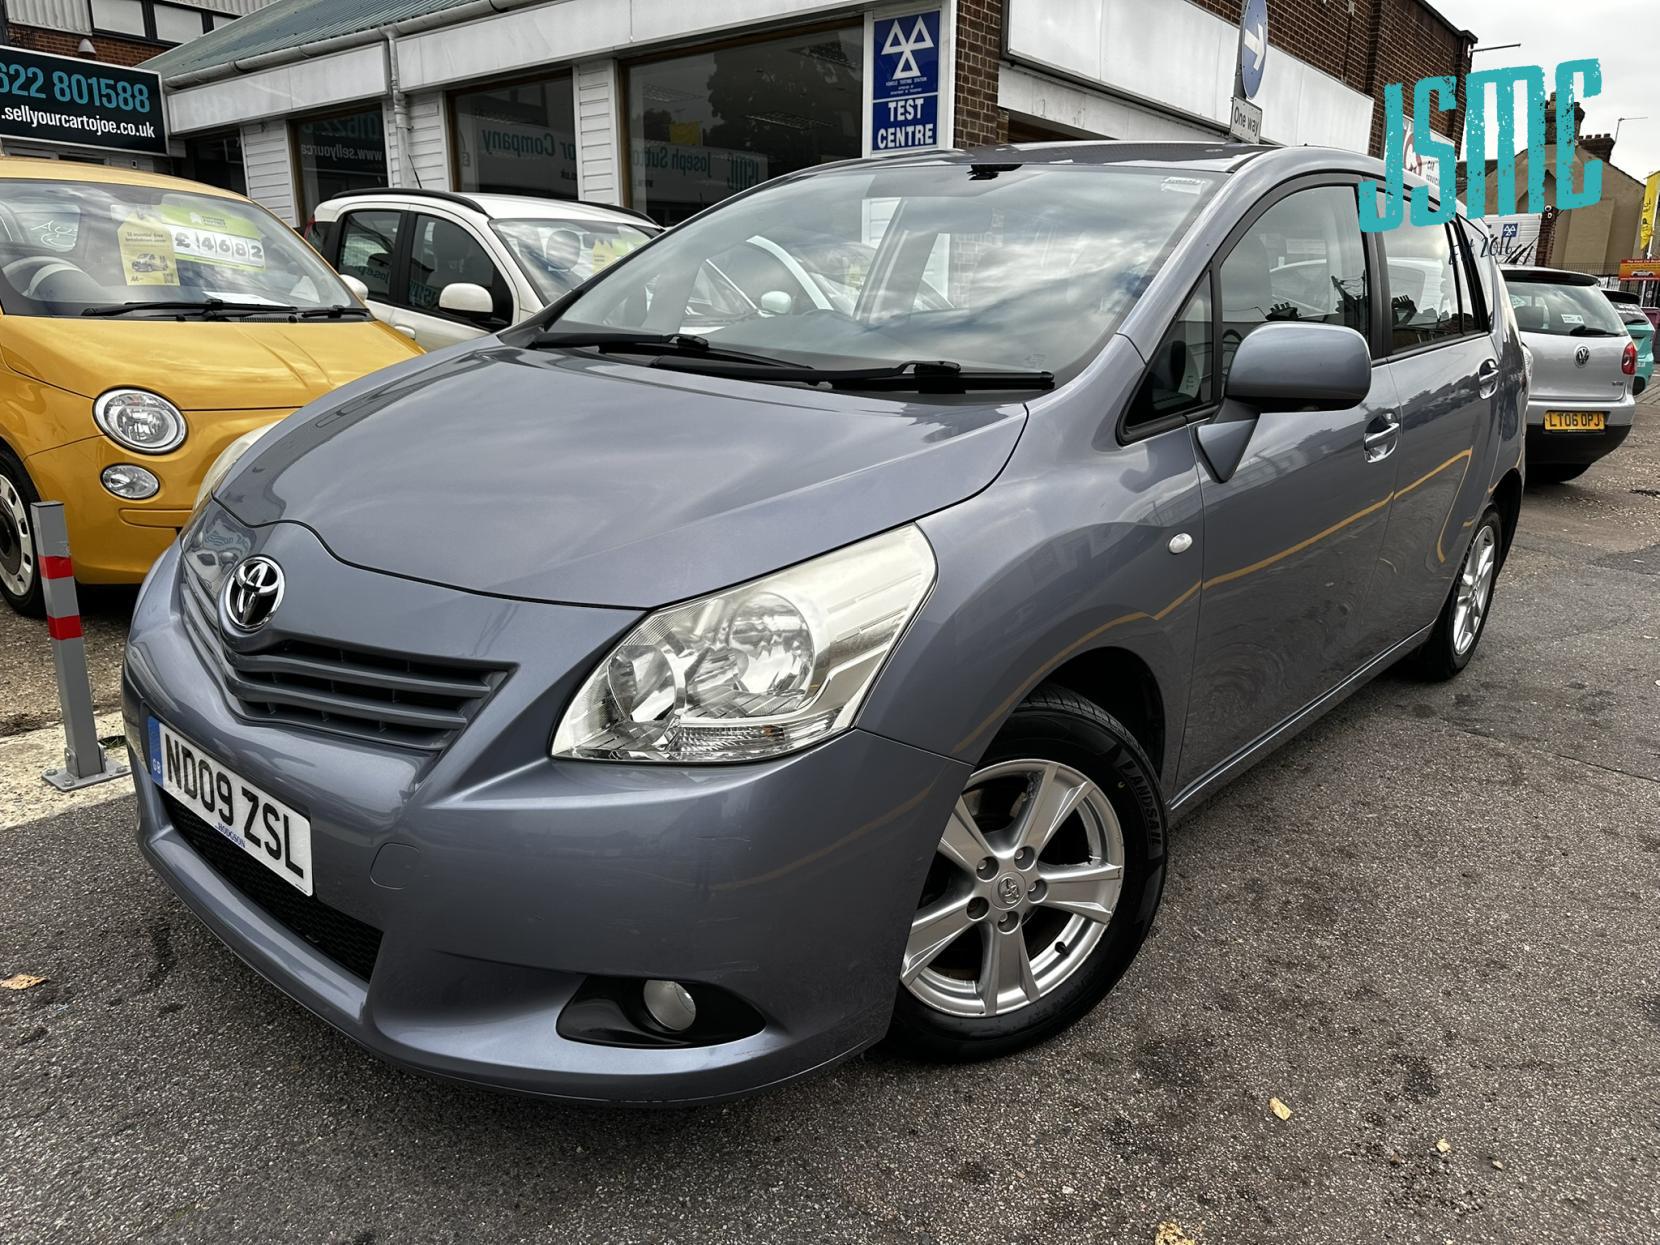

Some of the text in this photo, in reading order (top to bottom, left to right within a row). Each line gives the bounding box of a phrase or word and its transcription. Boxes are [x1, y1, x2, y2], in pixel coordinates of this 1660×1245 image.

[52, 71, 150, 113] 801588
[888, 98, 924, 122] TEST
[1233, 106, 1260, 137] One way
[877, 123, 934, 149] CENTRE
[1549, 412, 1601, 427] LT06 OPJ
[152, 758, 162, 775] GB
[165, 733, 304, 880] ND09 ZSL
